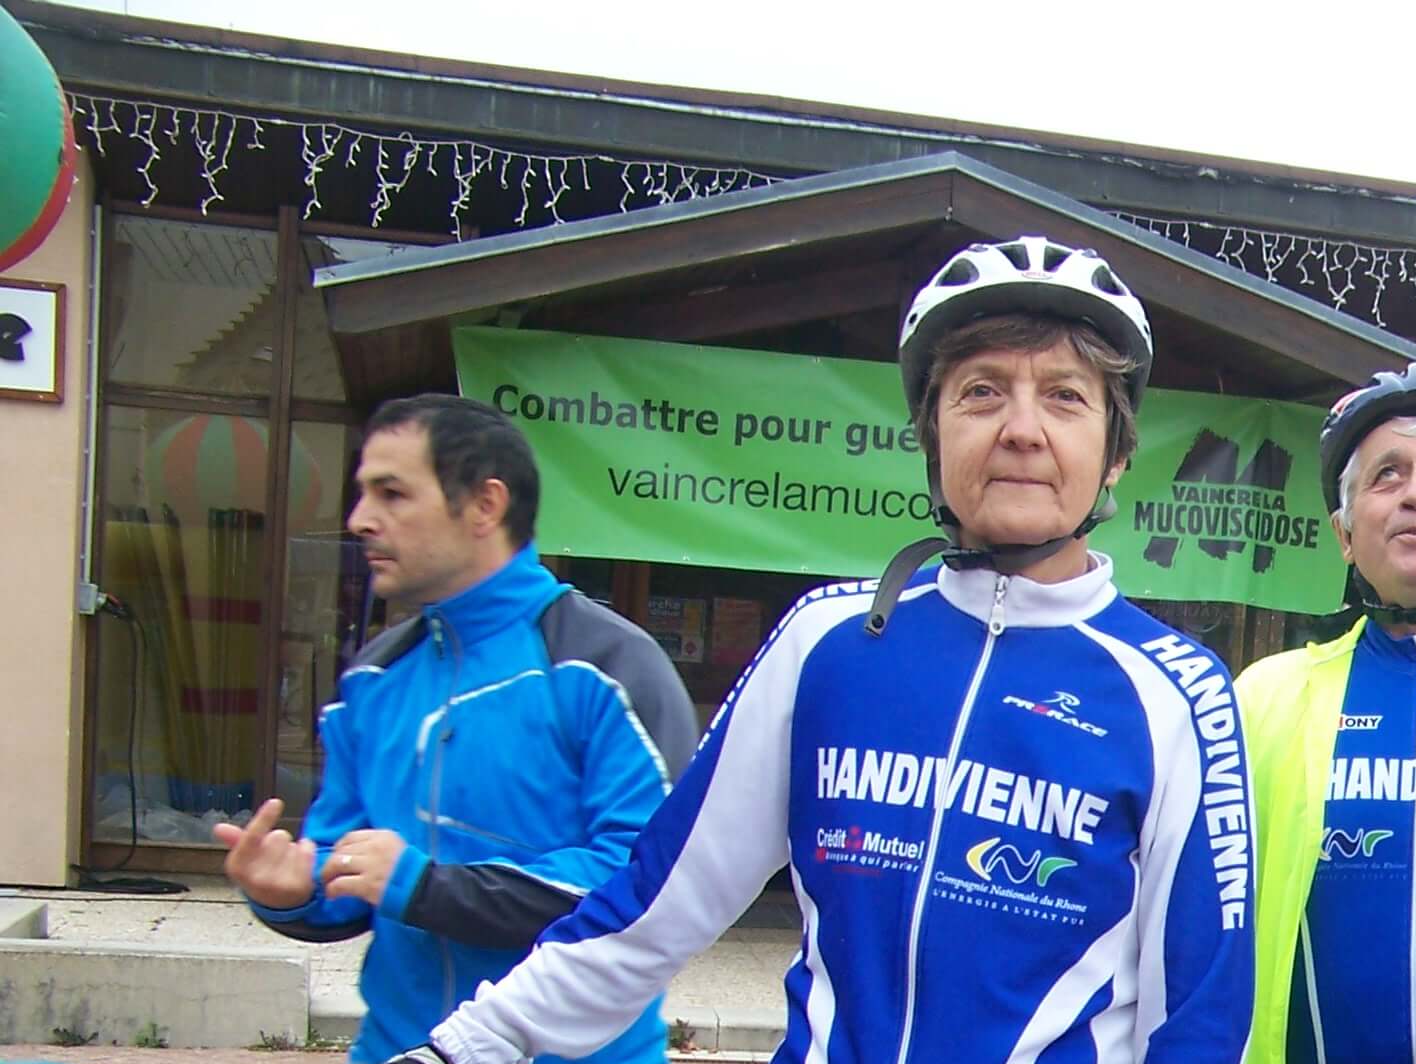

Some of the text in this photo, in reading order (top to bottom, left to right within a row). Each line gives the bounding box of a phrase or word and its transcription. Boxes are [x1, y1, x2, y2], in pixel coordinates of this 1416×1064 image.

[492, 384, 719, 438] Combattre
[733, 405, 831, 446] pour
[606, 463, 933, 521] vaincrelamuco
[1134, 501, 1320, 549] MUCOVISCIDOSE
[1340, 715, 1382, 729] ONY
[817, 747, 1110, 845] HANDIVIENNE
[862, 831, 925, 860] Mutuel
